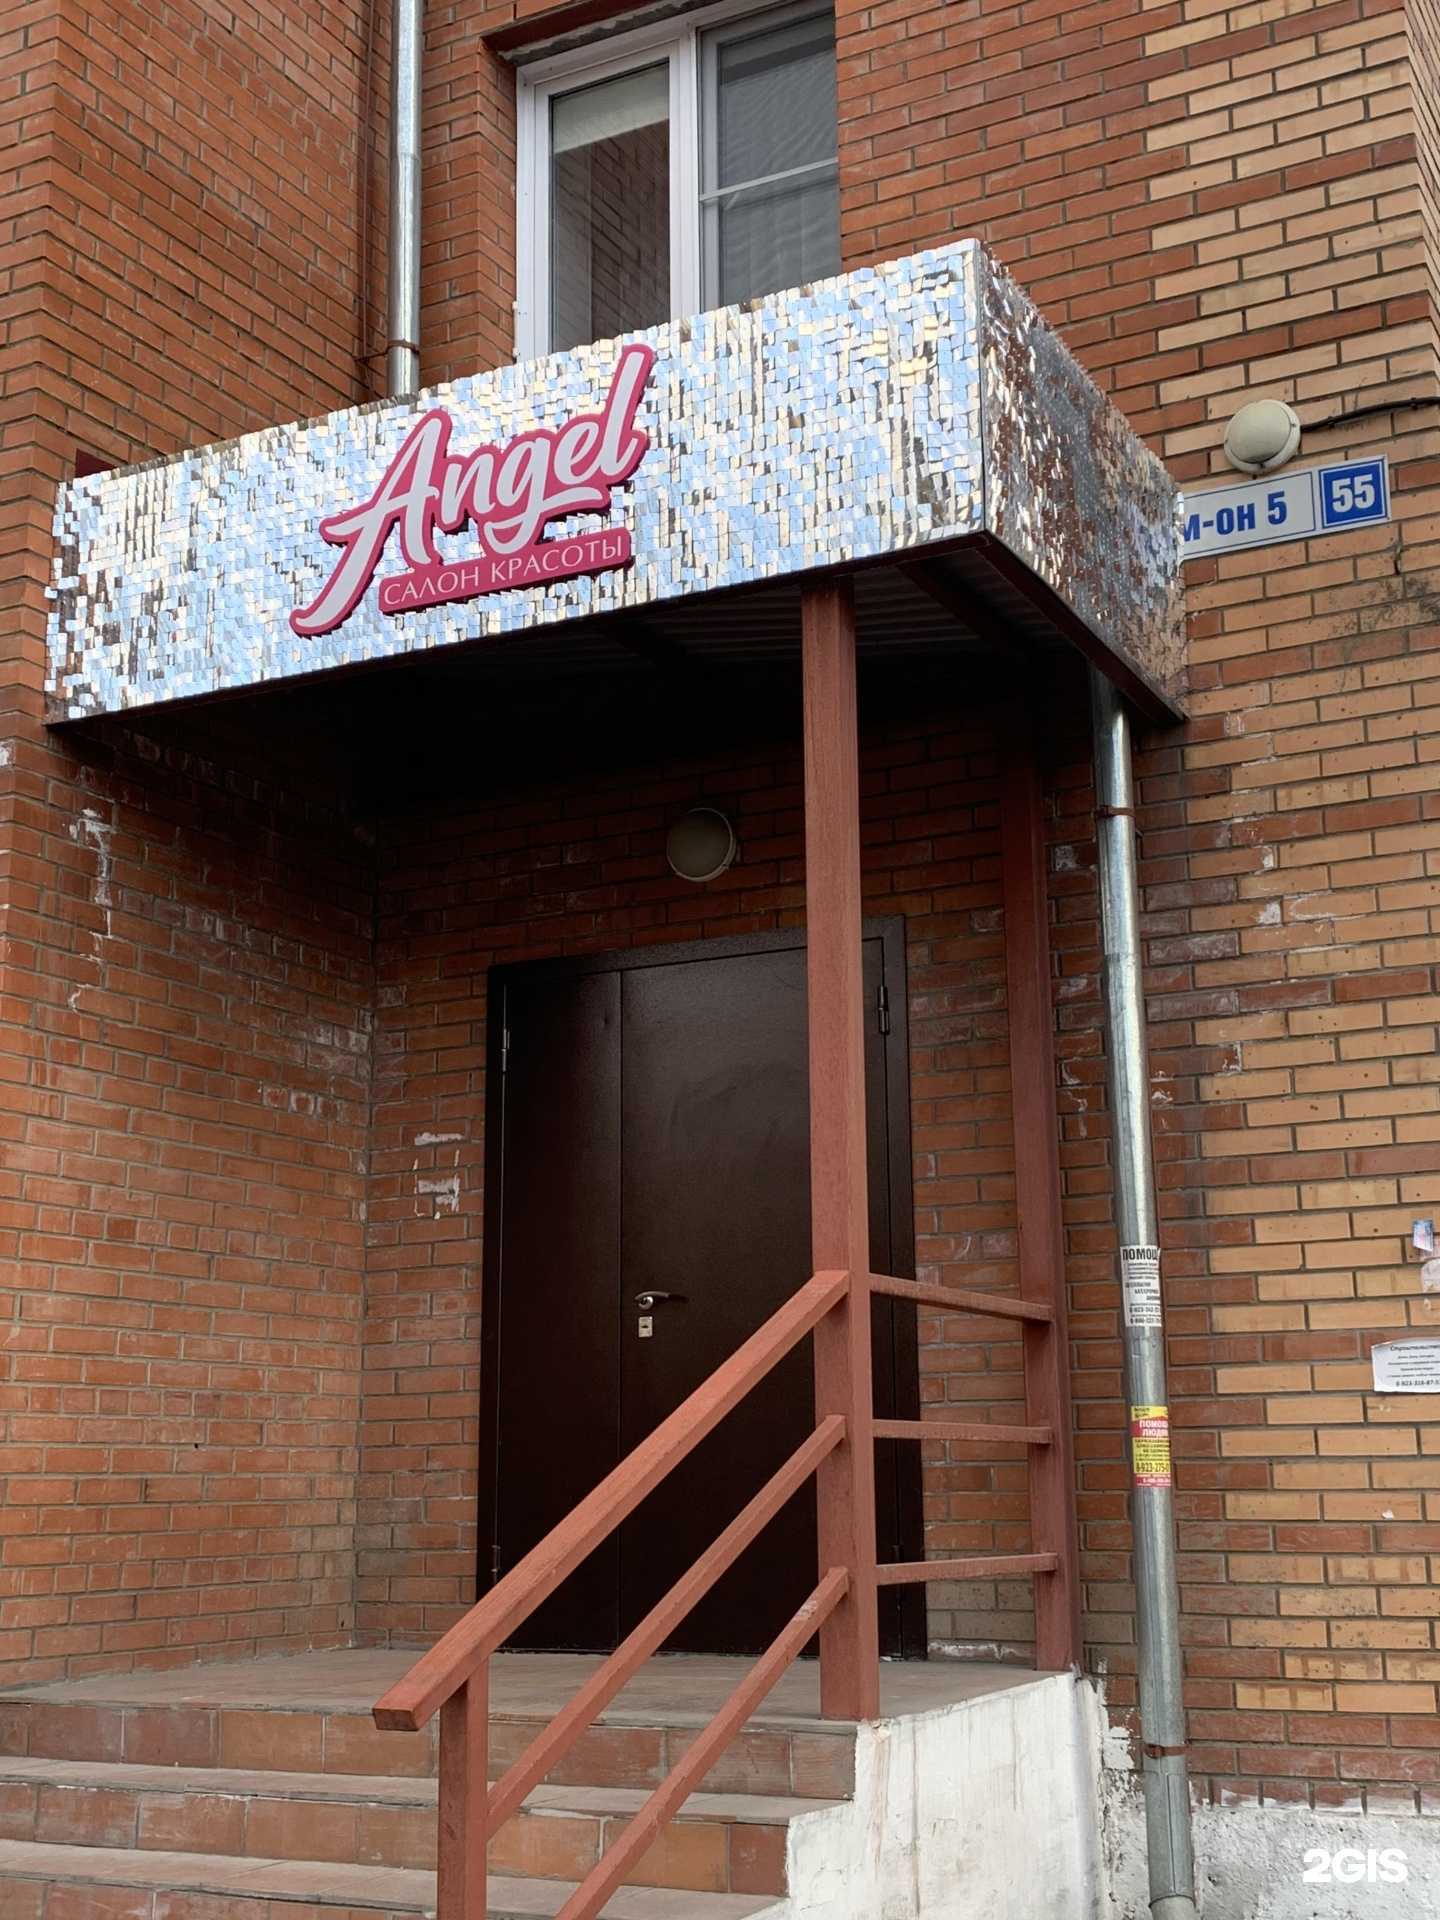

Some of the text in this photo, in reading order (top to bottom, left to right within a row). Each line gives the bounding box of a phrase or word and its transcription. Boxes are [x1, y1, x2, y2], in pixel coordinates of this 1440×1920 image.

[292, 347, 650, 632] Angel
[1267, 491, 1287, 525] 5
[1332, 474, 1376, 513] 55
[384, 535, 623, 605] САЛОН КРАСОТЫ
